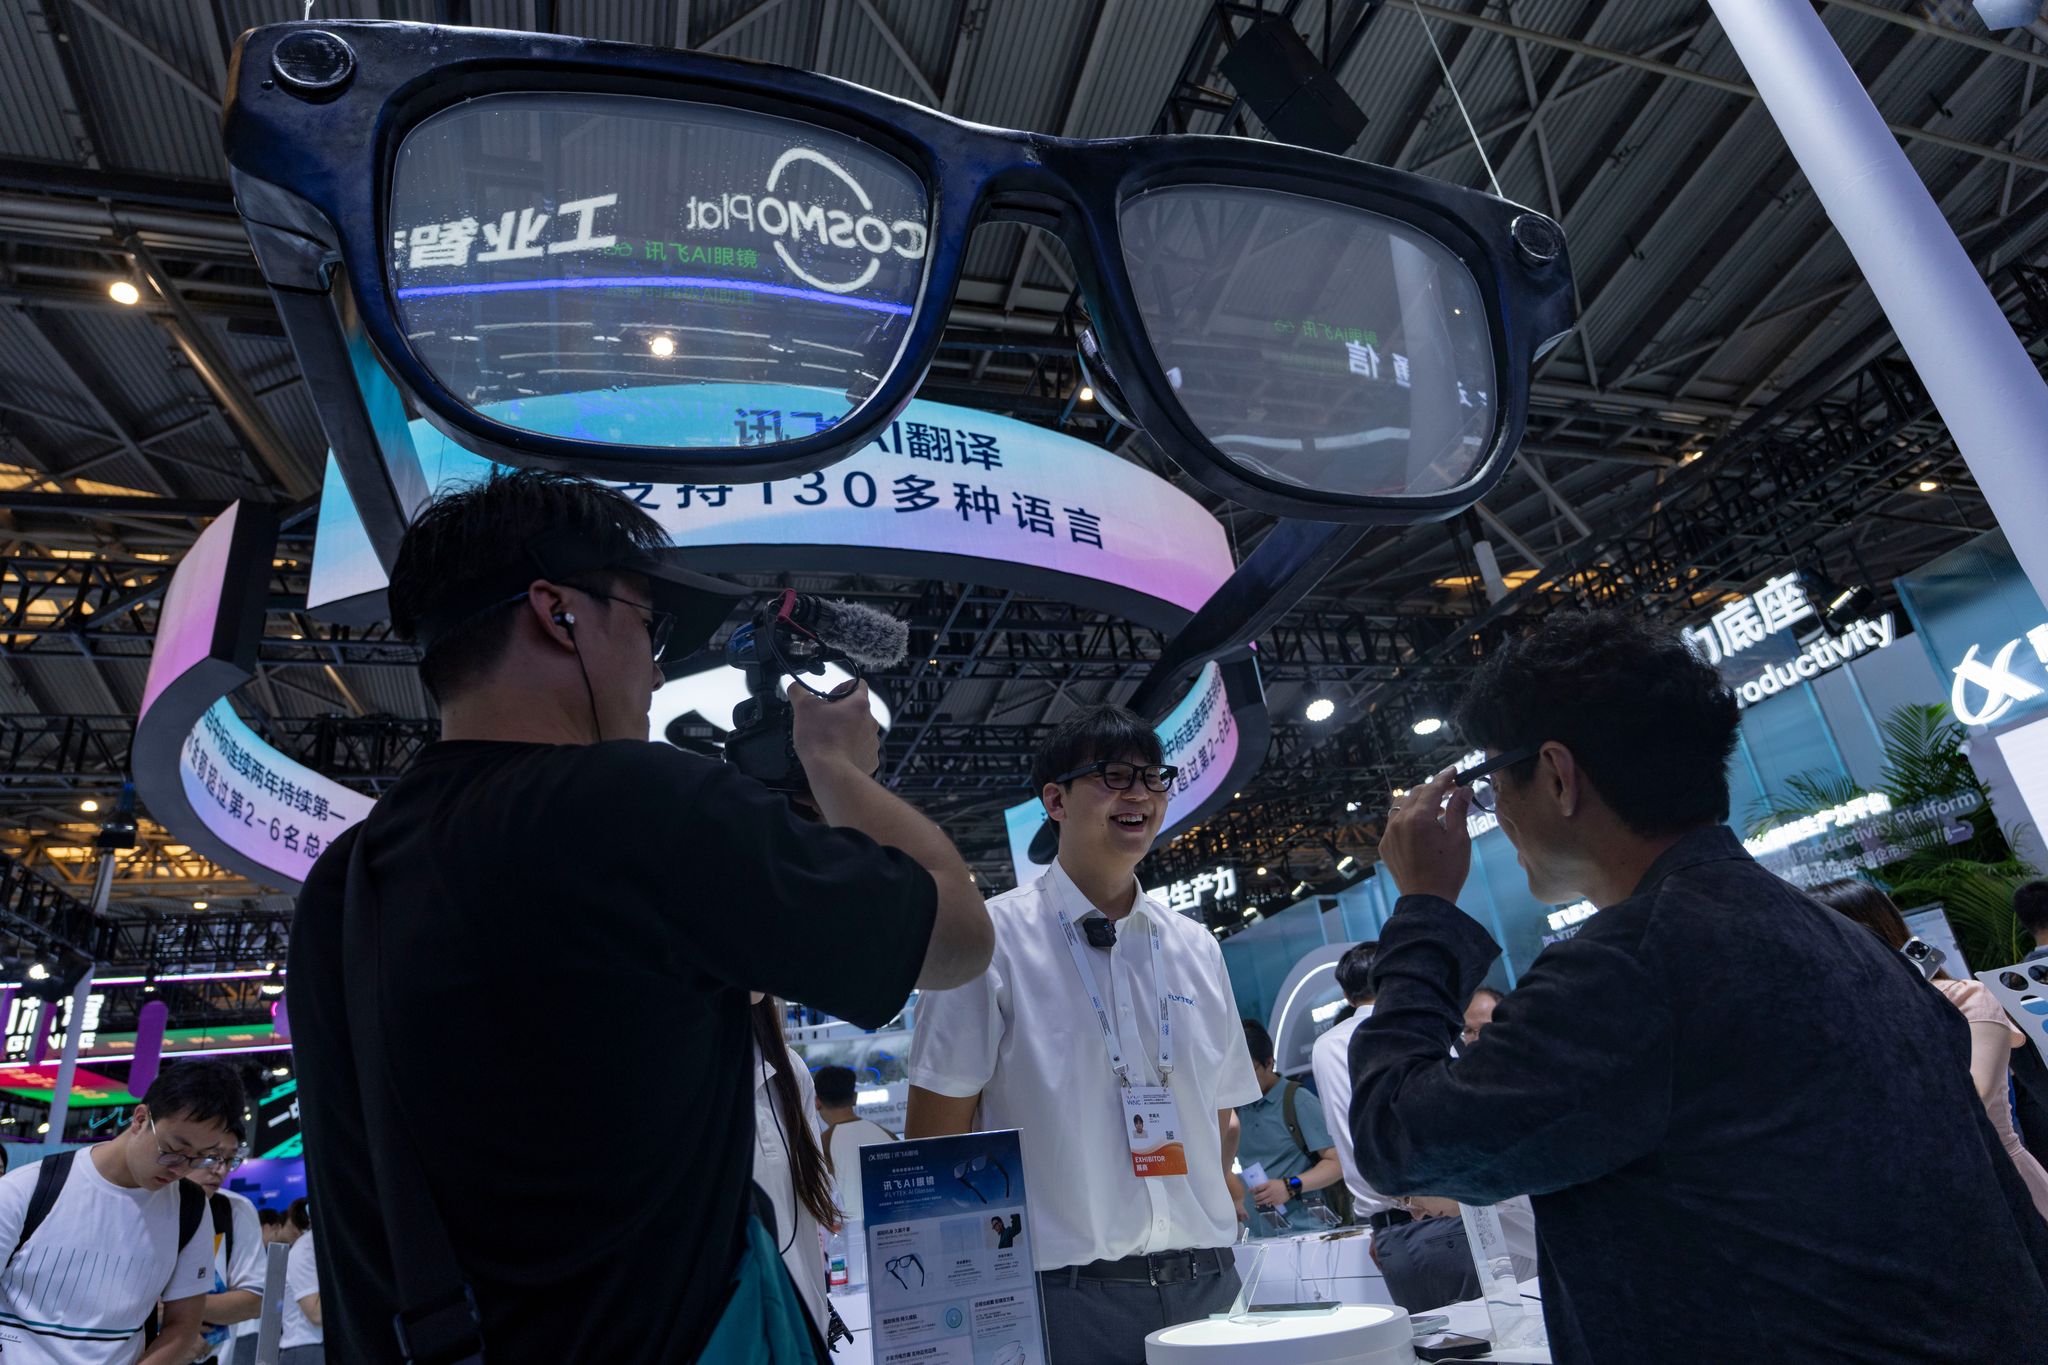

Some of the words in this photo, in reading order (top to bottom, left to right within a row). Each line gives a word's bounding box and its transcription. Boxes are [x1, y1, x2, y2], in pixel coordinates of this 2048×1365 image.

[645, 240, 760, 269] 讯飞AI眼镜
[734, 408, 1003, 471] 讯飞I翻译
[1734, 611, 1895, 709] roductivity
[188, 728, 332, 859] 金额超过第2-6名总
[1801, 818, 1892, 861] Productivity
[1895, 793, 1977, 826] Platform
[883, 1176, 935, 1191] 讯飞AI眼镜
